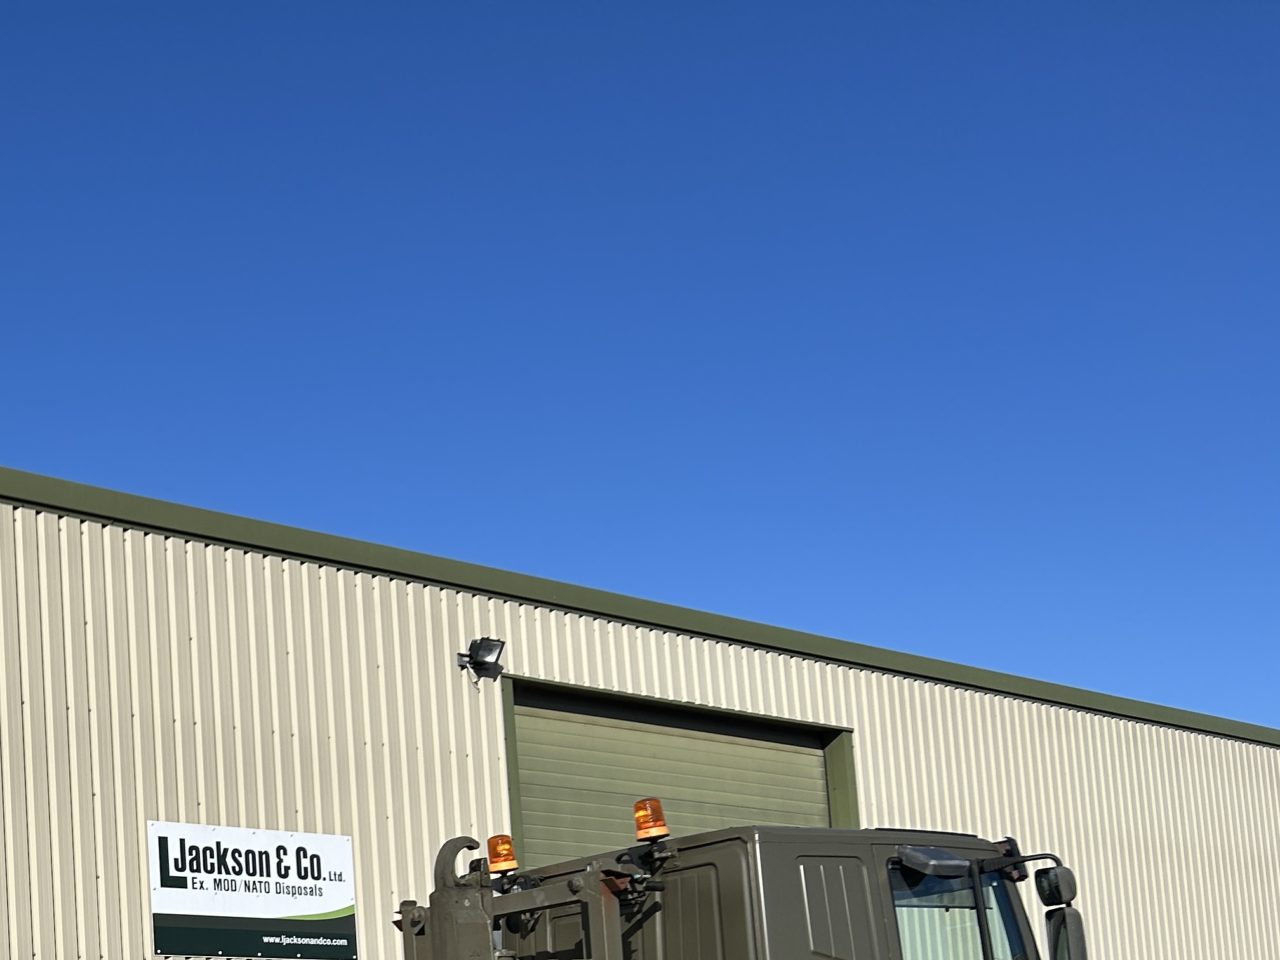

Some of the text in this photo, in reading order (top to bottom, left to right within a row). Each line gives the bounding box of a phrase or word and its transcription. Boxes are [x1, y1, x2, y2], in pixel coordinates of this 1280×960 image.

[276, 845, 291, 879] &
[296, 847, 326, 881] Co.
[328, 871, 346, 882] Ltd.
[191, 877, 209, 891] Ex.
[276, 882, 323, 897] Disposals
